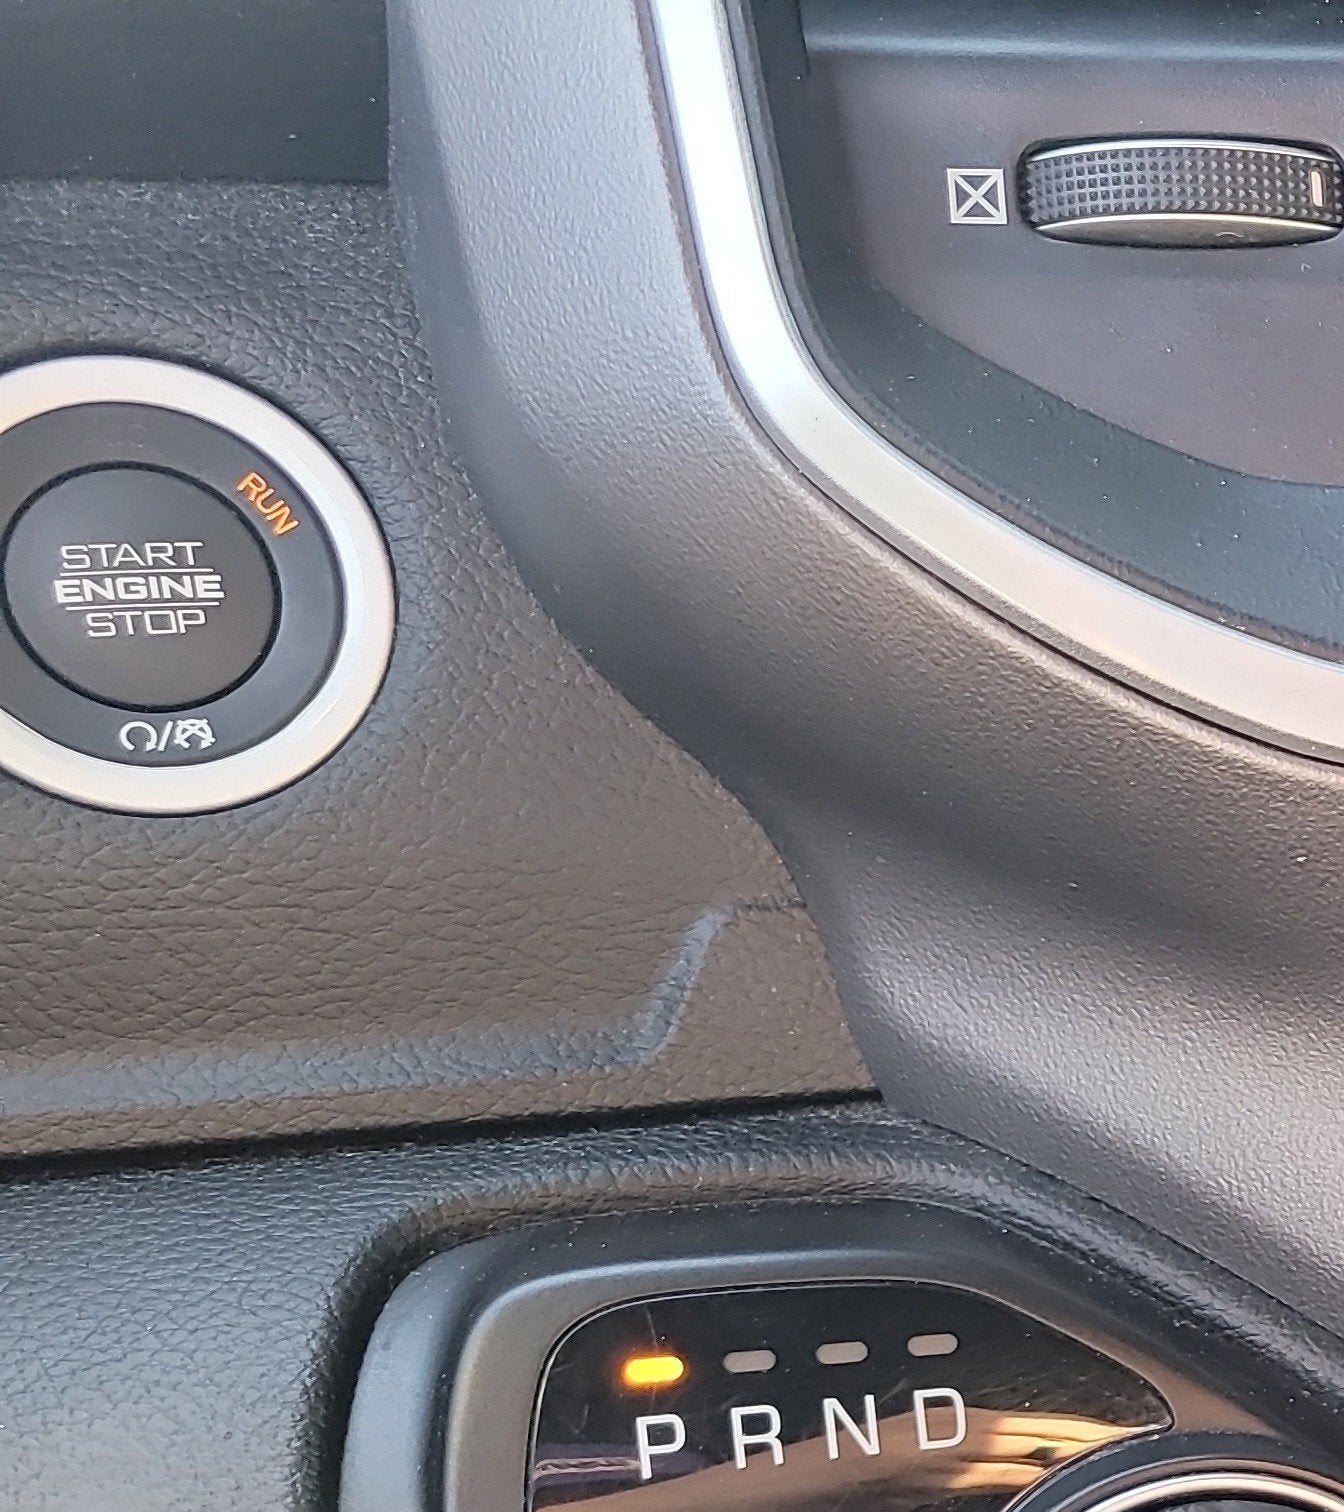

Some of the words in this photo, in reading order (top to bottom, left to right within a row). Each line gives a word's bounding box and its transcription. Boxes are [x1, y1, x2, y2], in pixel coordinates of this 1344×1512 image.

[236, 470, 299, 536] RUN
[60, 541, 204, 570] START
[54, 575, 225, 604] ENGINE
[85, 609, 207, 638] STOP
[635, 1413, 687, 1481] P
[730, 1405, 785, 1470] R
[822, 1394, 879, 1460] N
[913, 1387, 967, 1451] D
